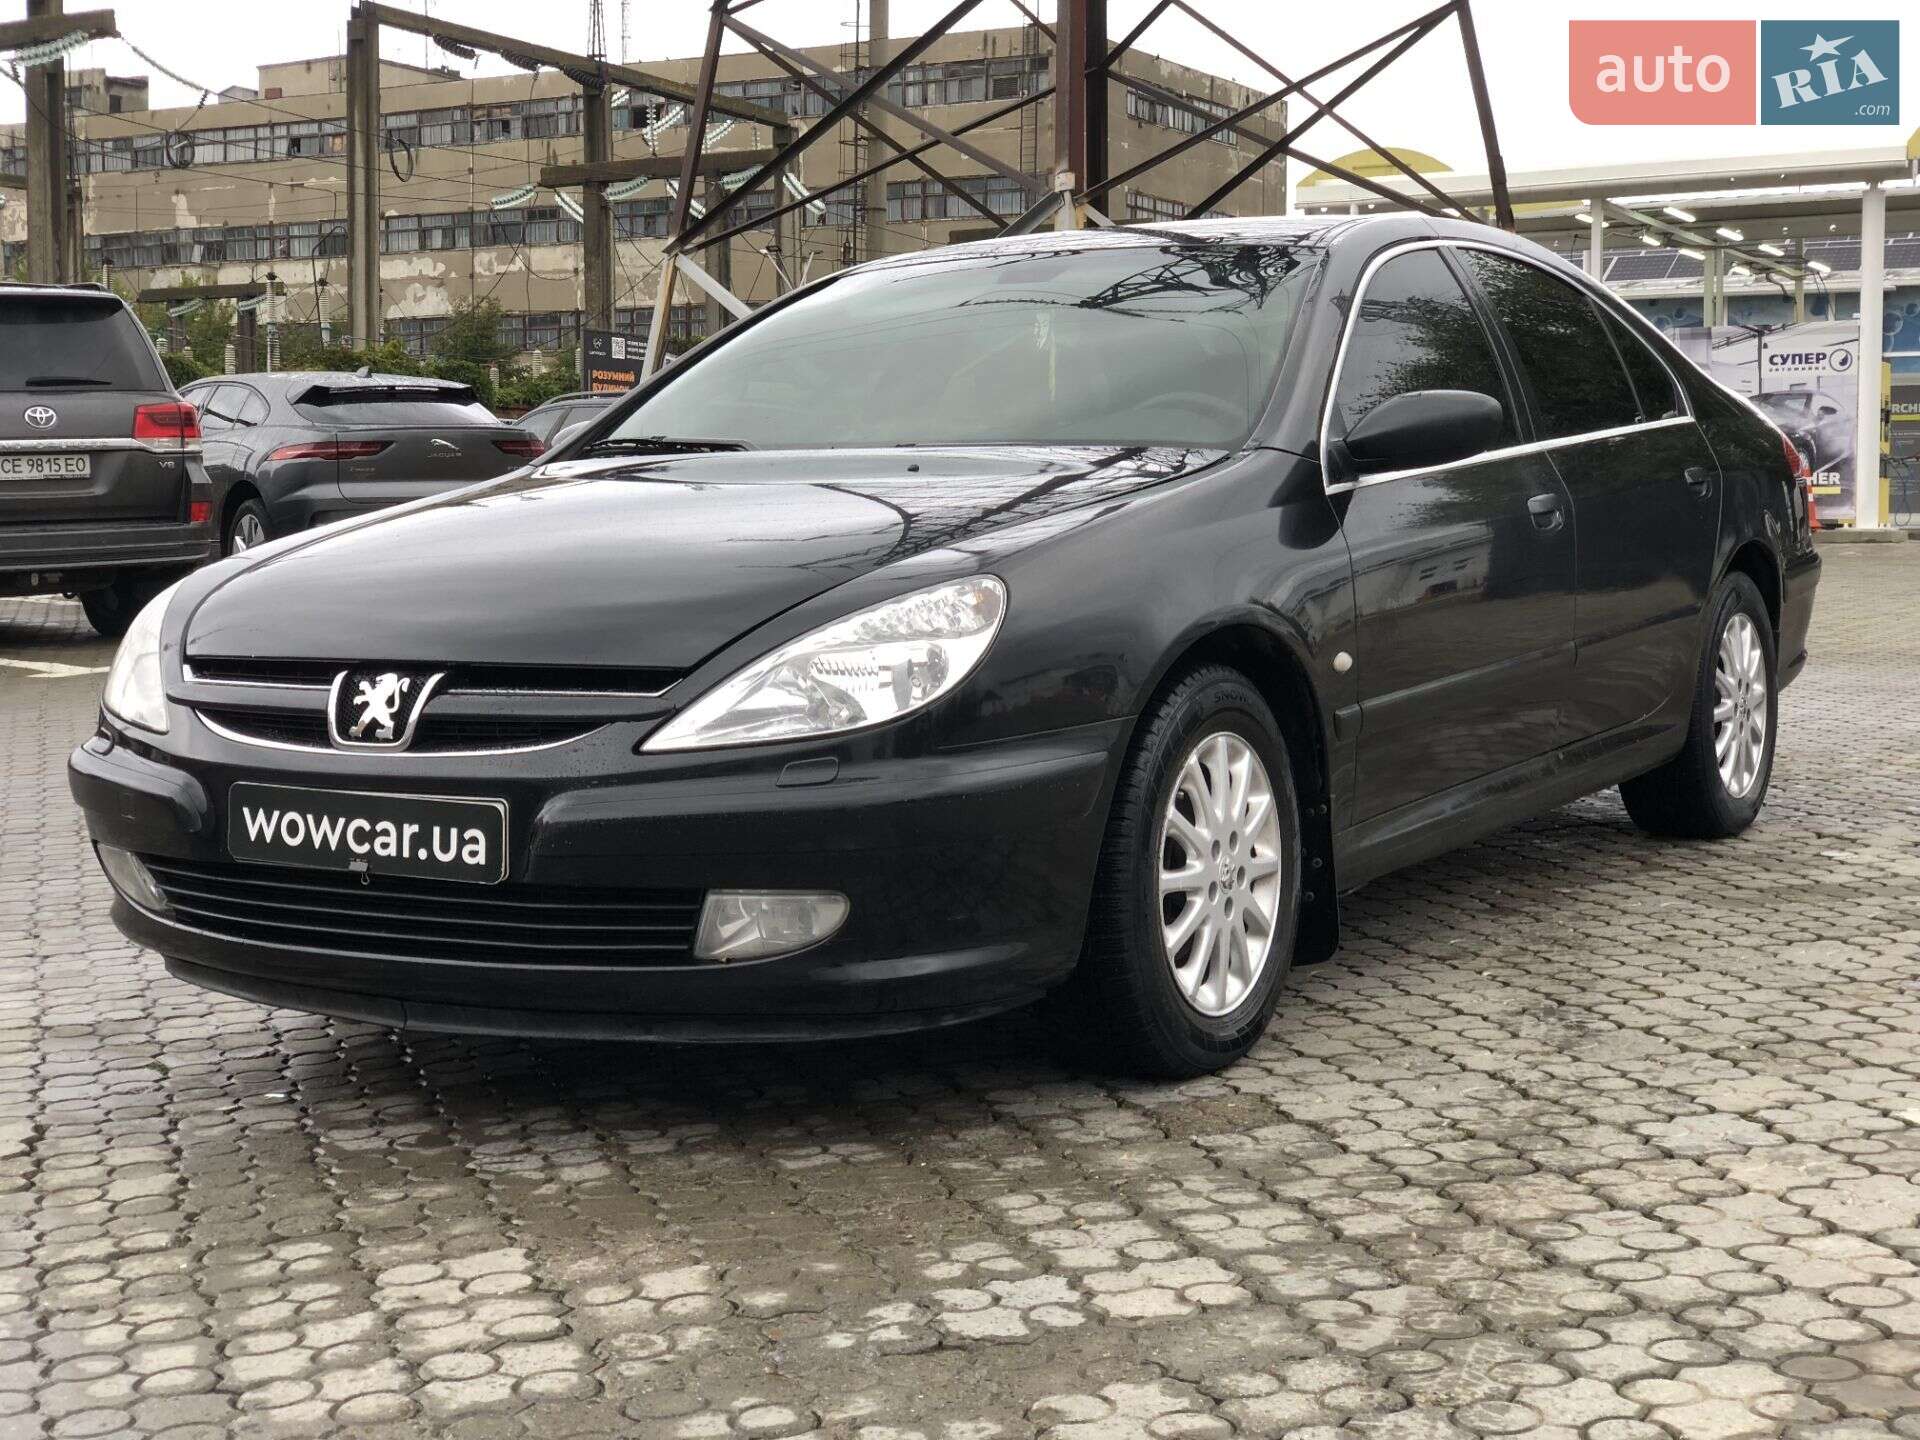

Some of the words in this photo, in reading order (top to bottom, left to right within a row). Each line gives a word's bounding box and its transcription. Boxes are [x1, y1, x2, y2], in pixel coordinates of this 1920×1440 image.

[1769, 352, 1827, 366] СУПЕР
[592, 370, 635, 382] РОЗУМНИЙ
[1, 458, 23, 474] CE
[27, 457, 61, 473] 9815
[64, 457, 86, 473] EO
[242, 806, 487, 866] wowcar.ua
